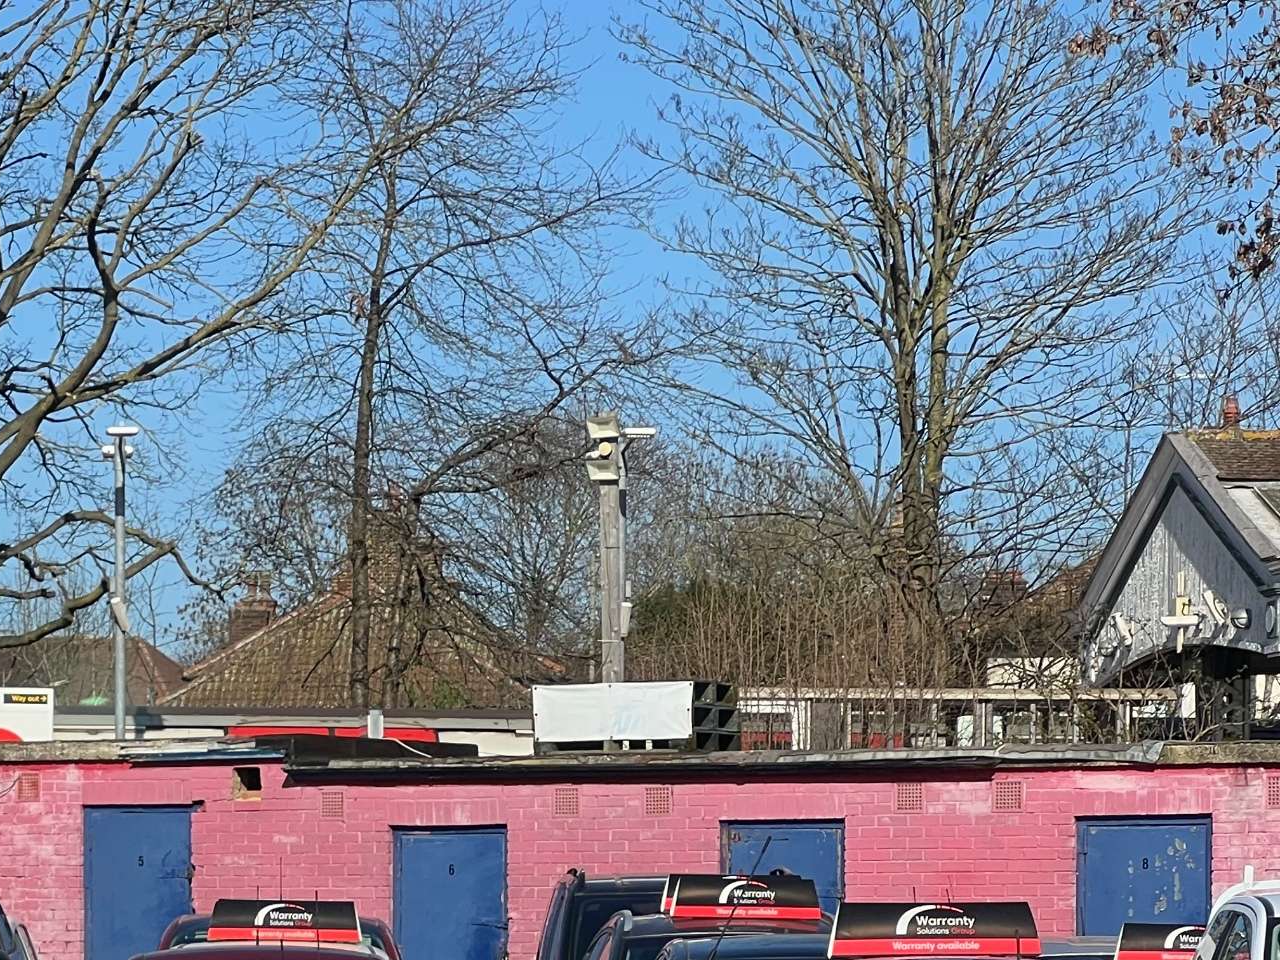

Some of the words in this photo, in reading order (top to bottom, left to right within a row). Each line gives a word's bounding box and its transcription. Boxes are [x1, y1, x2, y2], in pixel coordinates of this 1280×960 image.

[138, 855, 144, 866] 5
[1142, 857, 1149, 870] 8
[448, 863, 455, 876] 6
[733, 889, 776, 901] Warranty
[270, 911, 313, 922] Warranty
[915, 915, 976, 929] Warranty
[916, 927, 950, 935] Solutions
[951, 927, 976, 936] Group
[892, 941, 935, 952] Warranty
[937, 940, 980, 950] available
